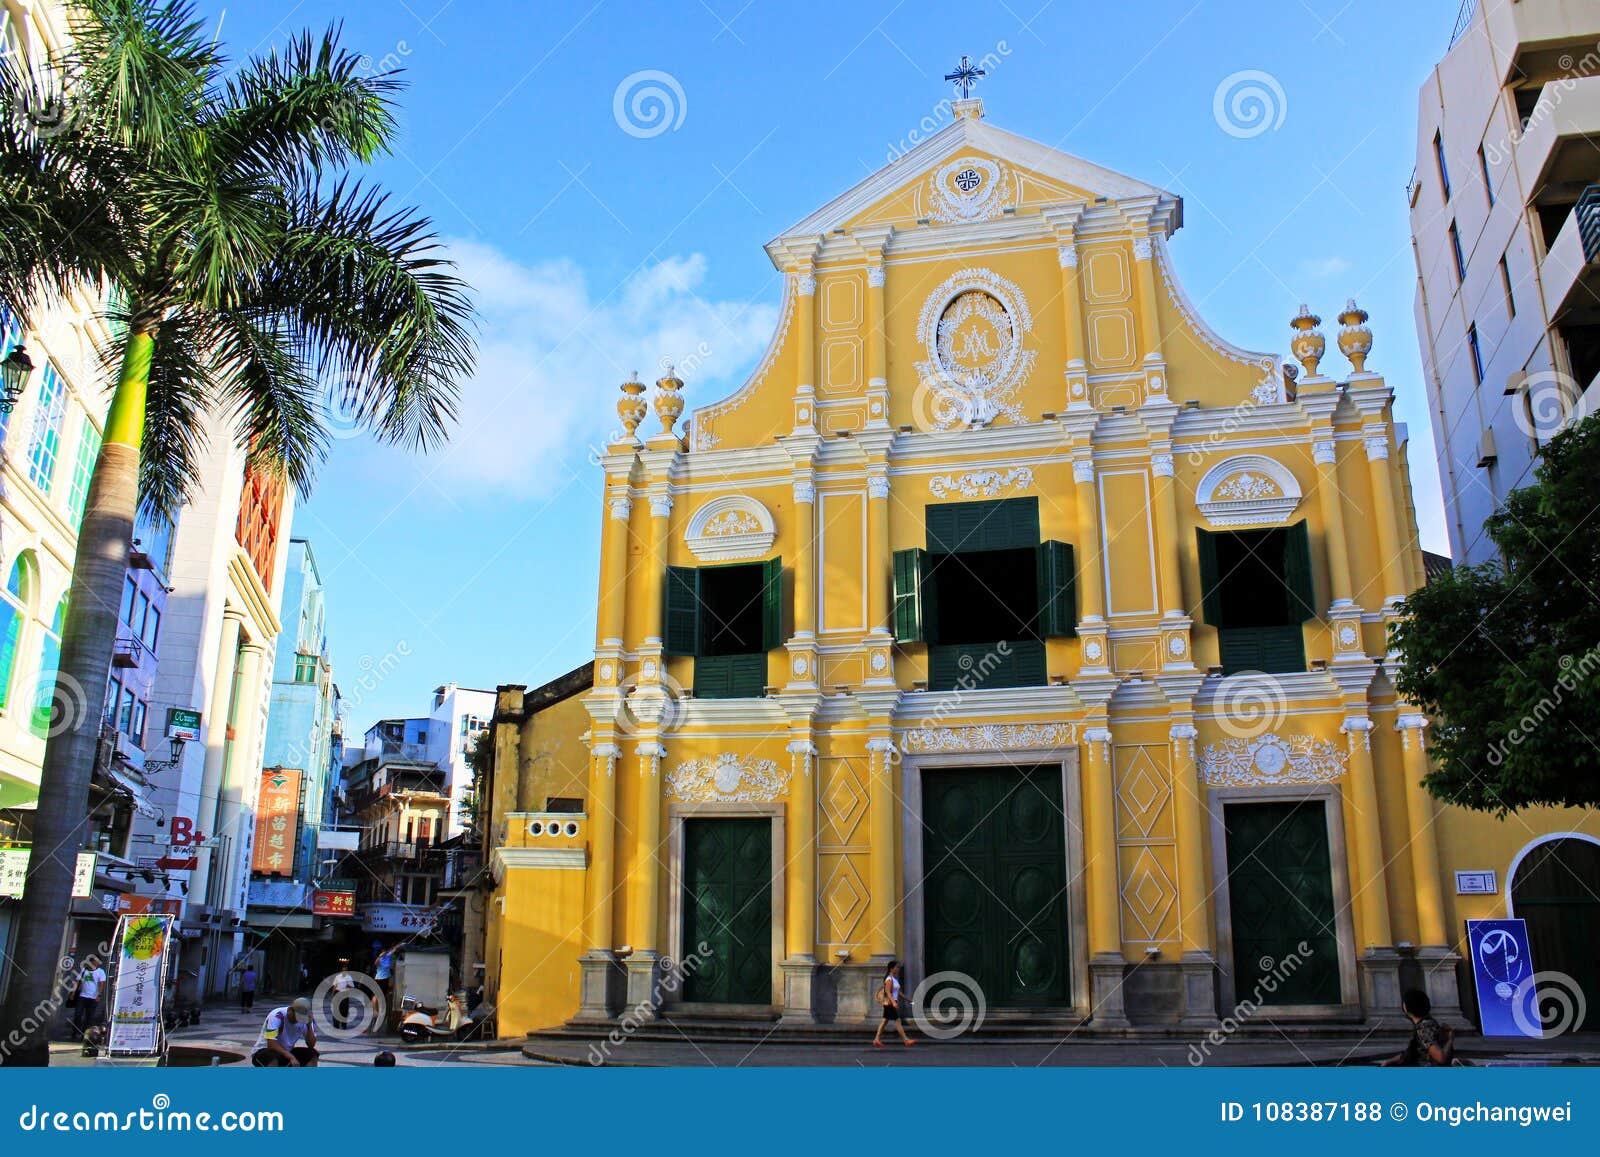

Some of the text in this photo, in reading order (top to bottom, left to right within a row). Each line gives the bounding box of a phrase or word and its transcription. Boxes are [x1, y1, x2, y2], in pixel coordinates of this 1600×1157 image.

[171, 816, 206, 846] B+
[267, 797, 292, 870] 新苗超市
